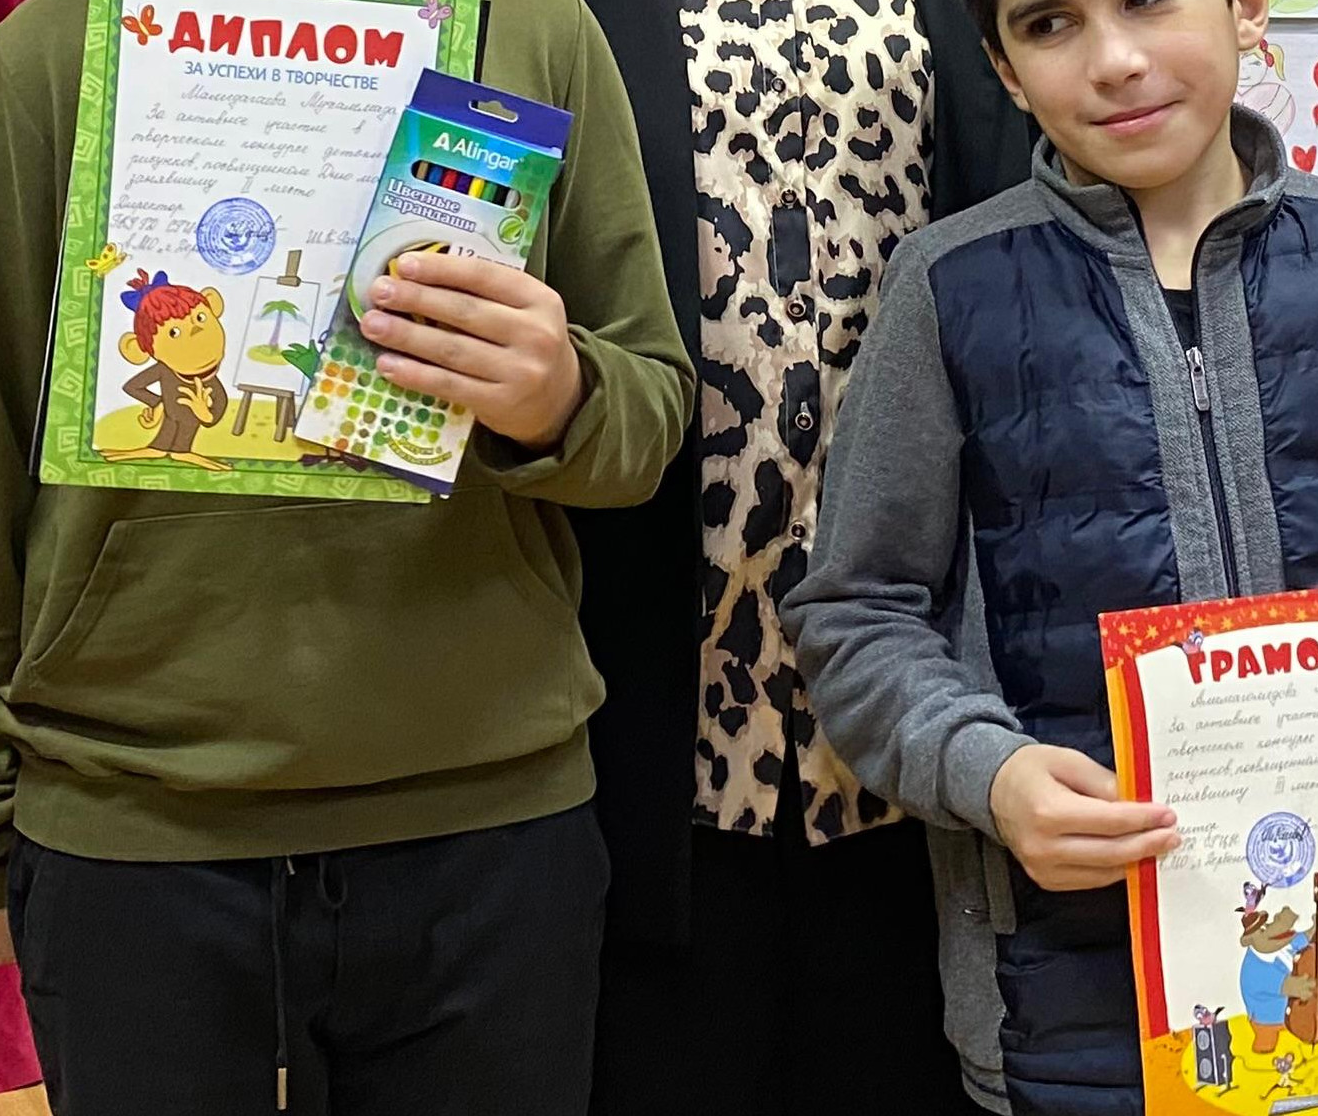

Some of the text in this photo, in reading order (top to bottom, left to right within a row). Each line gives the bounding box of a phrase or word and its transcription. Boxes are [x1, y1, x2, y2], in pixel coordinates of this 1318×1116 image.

[168, 10, 405, 68] ДИПЛОМ
[184, 60, 379, 91] ЗА УСПЕХИ В ТВОРЧЕСТВЕ
[452, 137, 519, 172] Alingar
[382, 194, 478, 233] карандаши
[386, 177, 462, 214] Цветные
